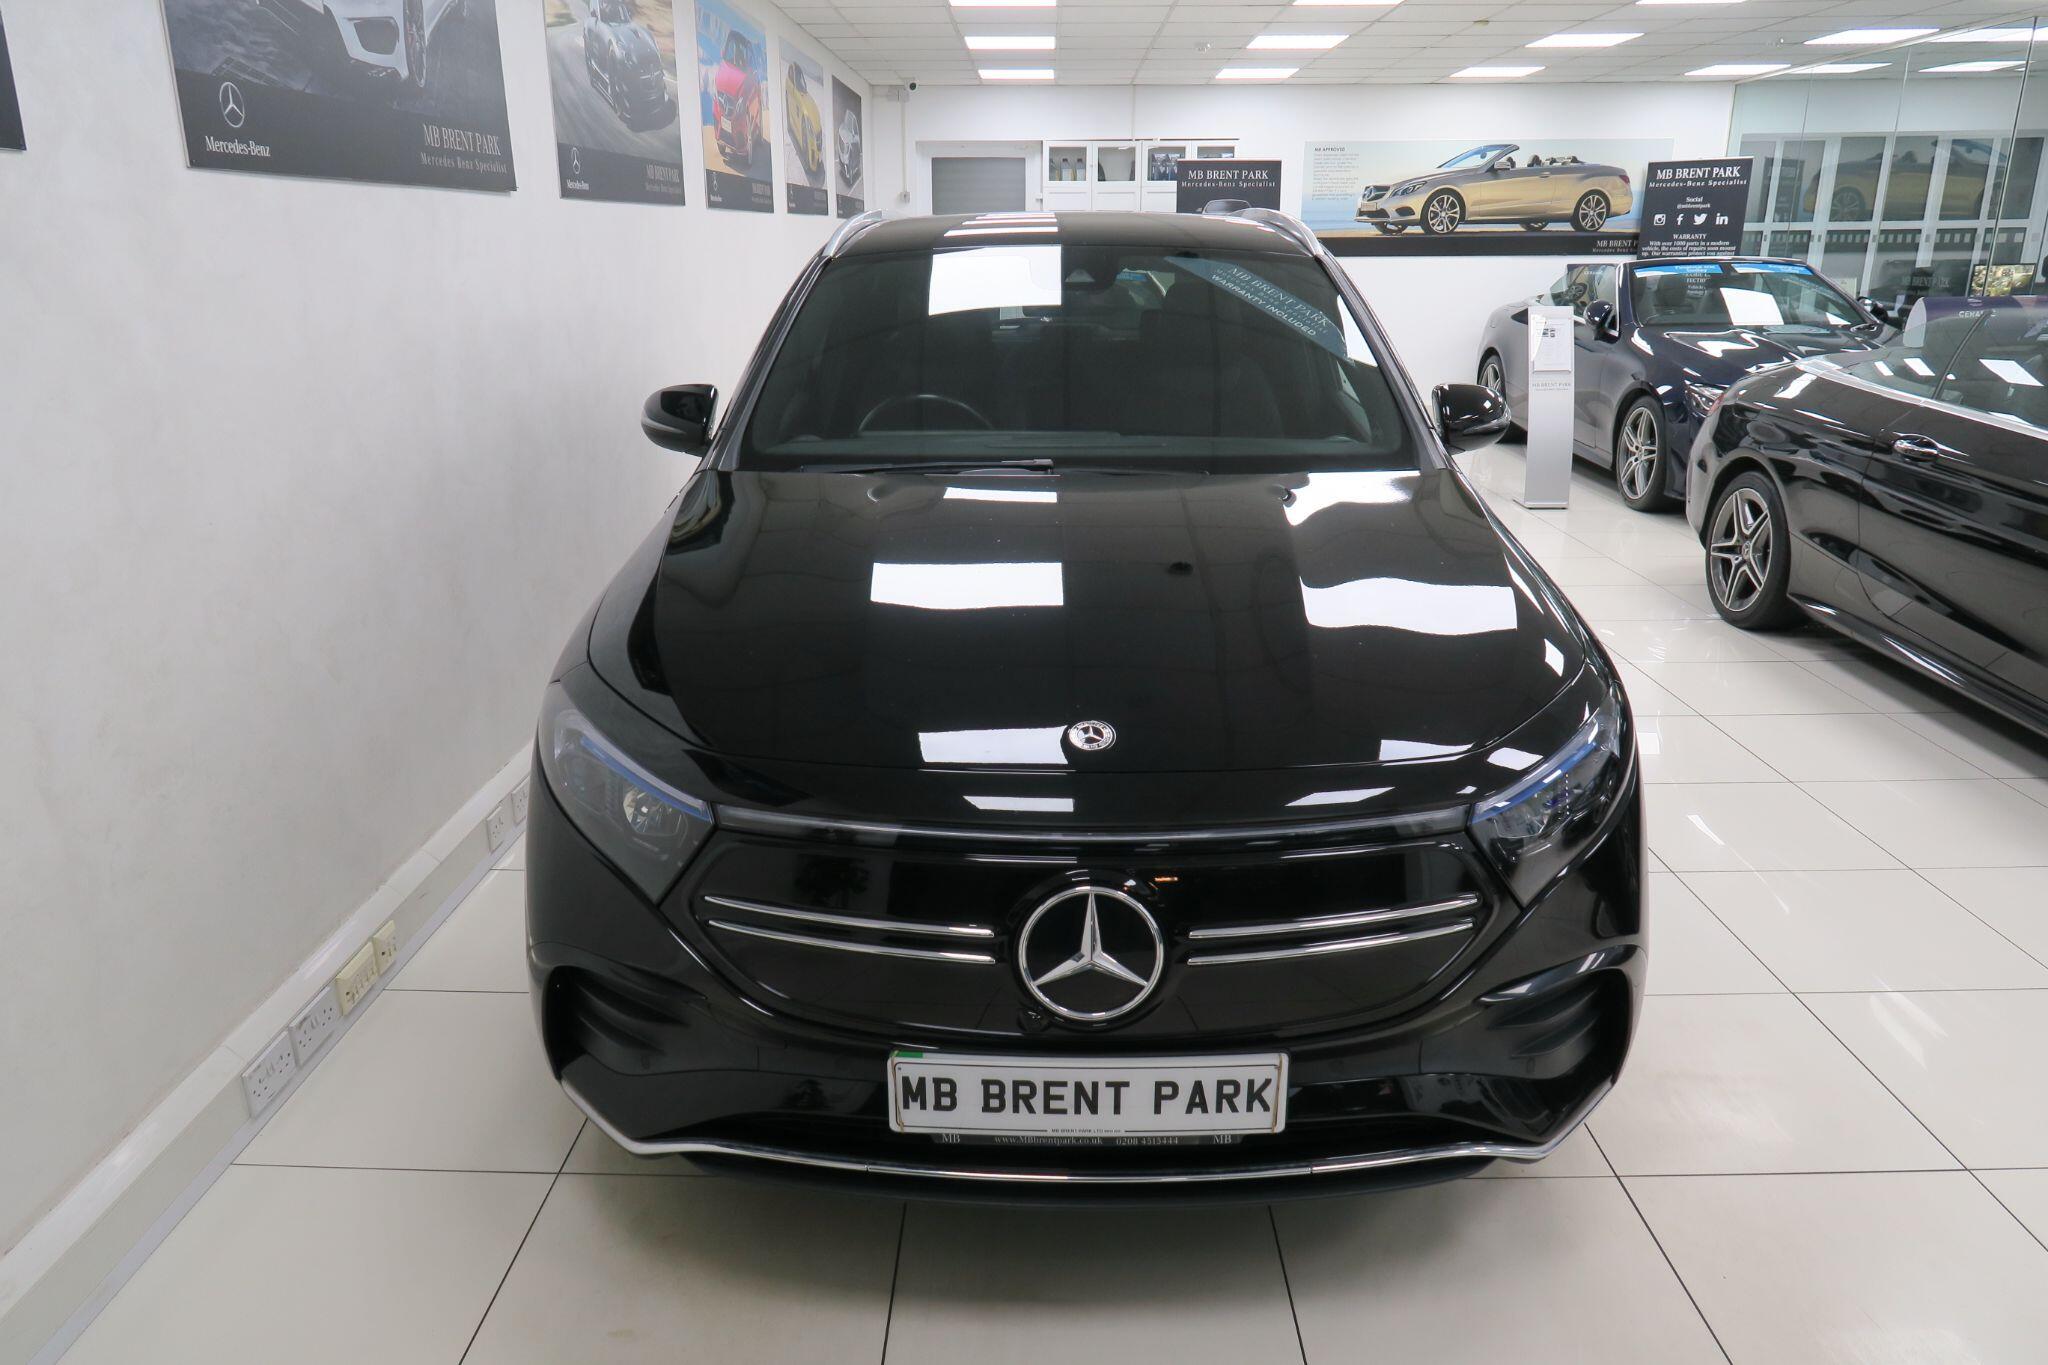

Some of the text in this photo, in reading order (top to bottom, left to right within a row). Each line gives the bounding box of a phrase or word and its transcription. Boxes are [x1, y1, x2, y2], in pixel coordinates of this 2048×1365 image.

[205, 135, 271, 157] Mercedes-Benz
[423, 124, 501, 156] MB BRENT PARK
[1188, 170, 1269, 180] MB BRENT PARK
[1656, 166, 1741, 180] MB BRENT PARK
[1649, 179, 1747, 188] Mercedes-Benz Specialist
[1716, 213, 1729, 225] in
[1212, 274, 1317, 336] WARRANTY INCLUDED
[1230, 268, 1327, 327] MB BRENT PARK
[902, 1075, 1272, 1115] MB BRENT PARK
[942, 1133, 960, 1144] MB
[1213, 1134, 1232, 1144] MB
